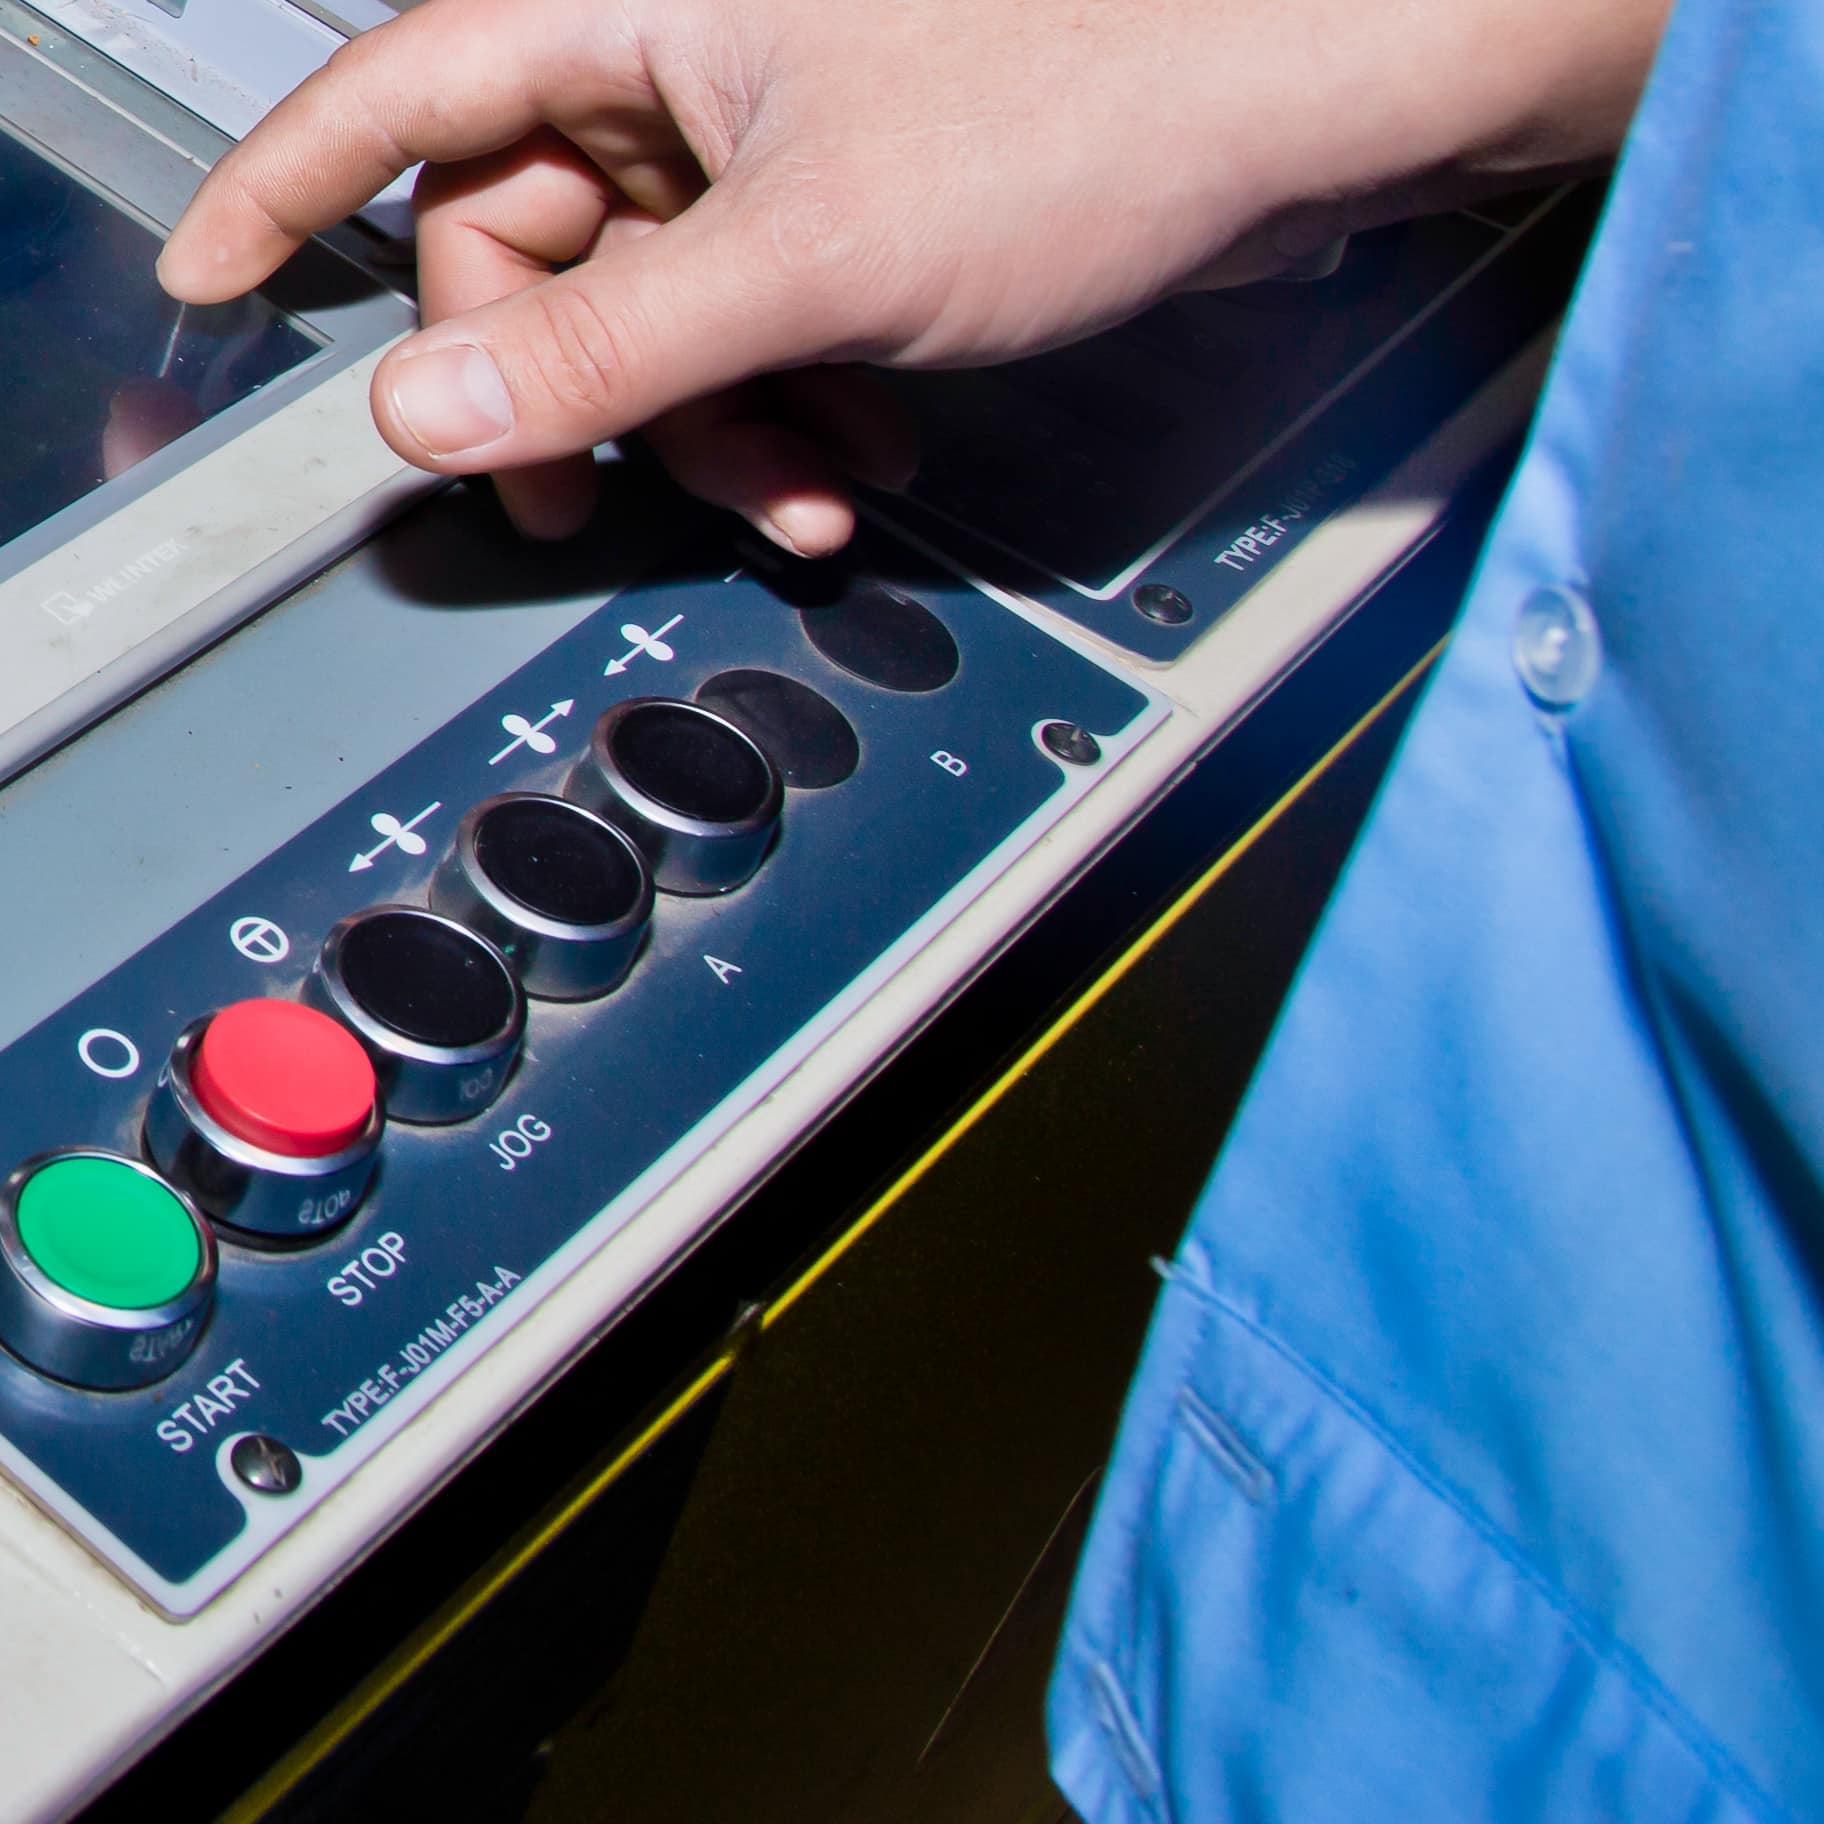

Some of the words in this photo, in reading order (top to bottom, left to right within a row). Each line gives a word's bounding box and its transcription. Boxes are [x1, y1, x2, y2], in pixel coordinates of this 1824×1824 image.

[930, 749, 968, 778] B
[703, 952, 742, 984] A
[489, 1113, 552, 1171] JOG
[326, 1230, 406, 1307] STOP
[156, 1357, 260, 1453] START
